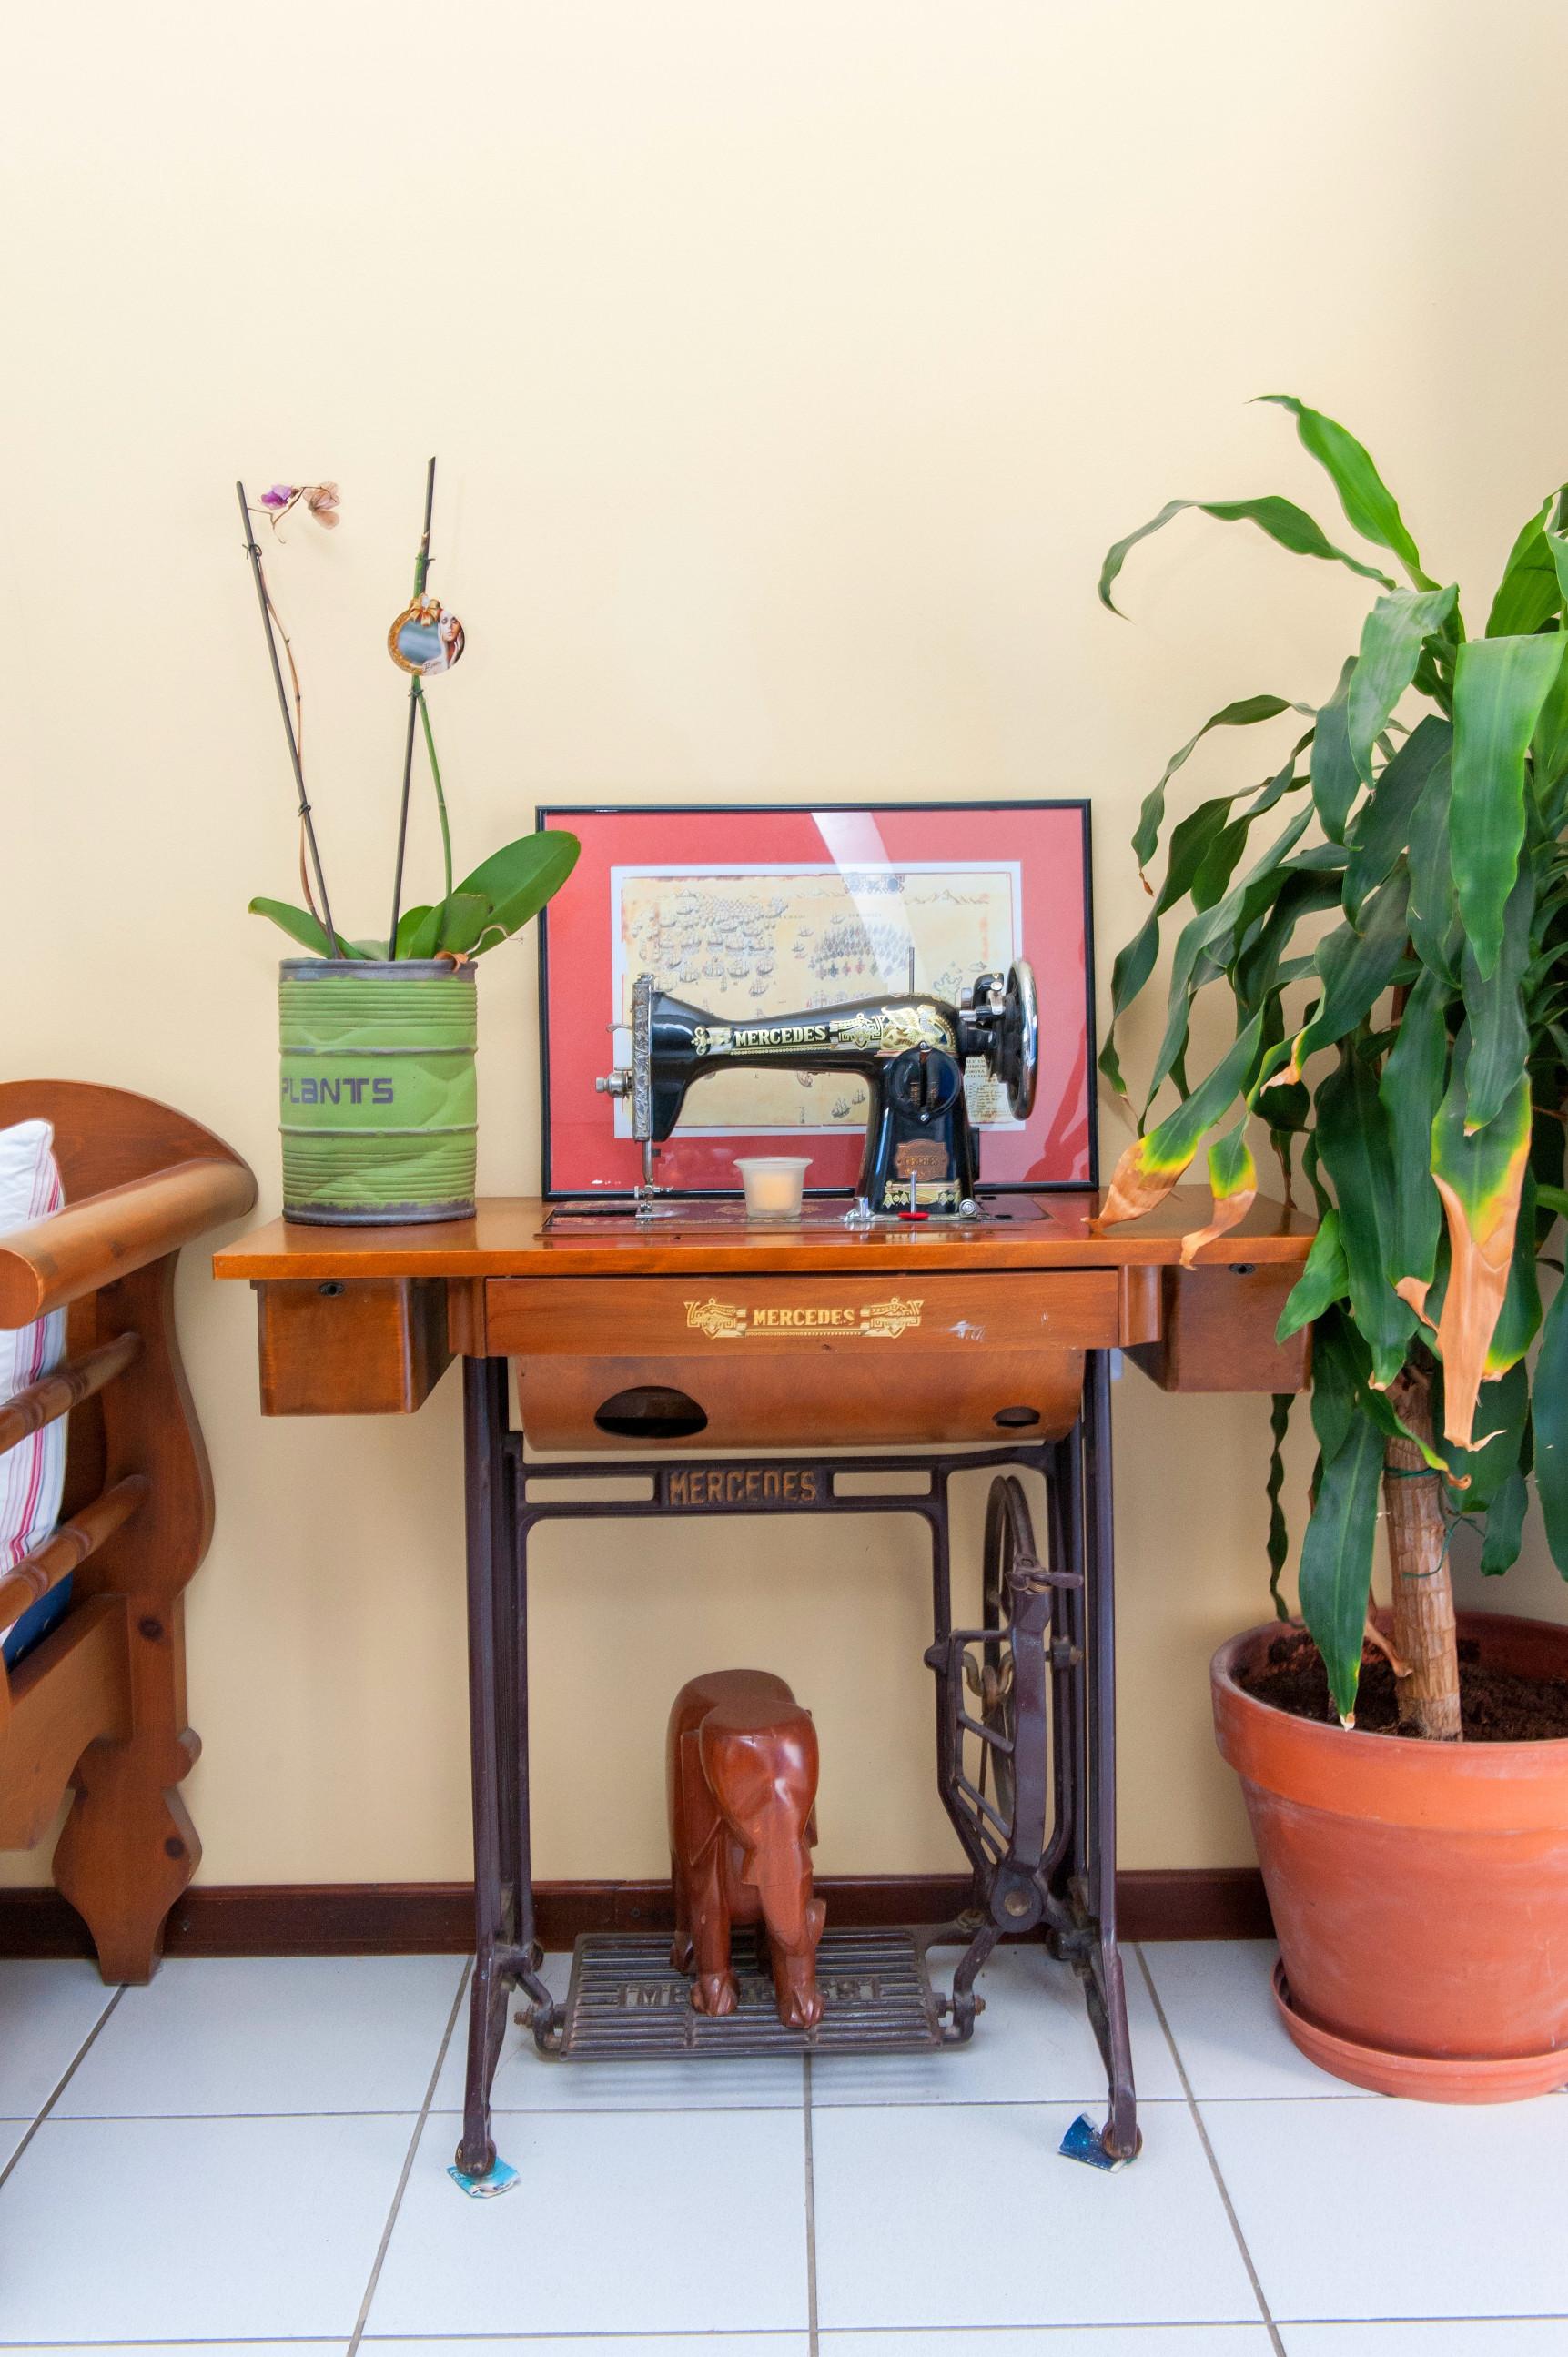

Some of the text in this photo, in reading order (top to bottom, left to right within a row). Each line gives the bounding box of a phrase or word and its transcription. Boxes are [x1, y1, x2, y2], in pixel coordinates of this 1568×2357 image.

[734, 1025, 827, 1047] MERCEDES
[753, 1309, 855, 1326] MERCEDES
[669, 1470, 816, 1506] MERCEDES
